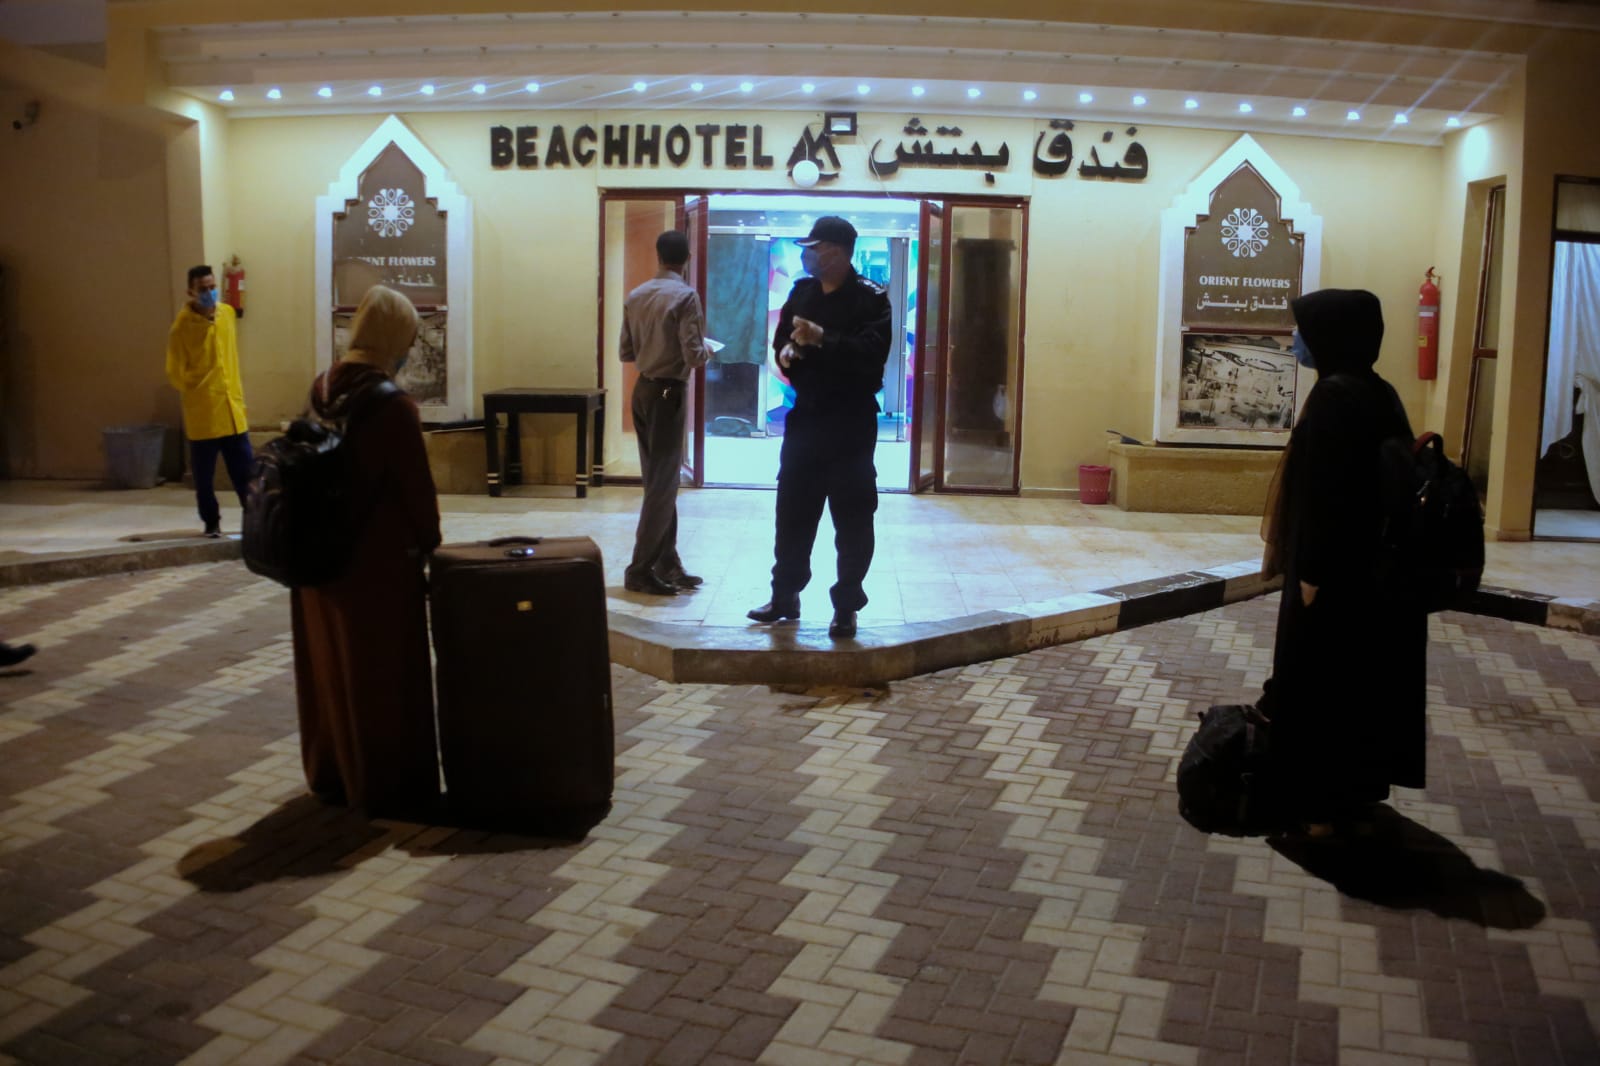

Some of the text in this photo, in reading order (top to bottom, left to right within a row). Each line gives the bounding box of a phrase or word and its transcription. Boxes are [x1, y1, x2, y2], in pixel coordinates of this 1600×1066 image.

[490, 123, 774, 168] BEACHHOTEL
[1032, 120, 1149, 180] فندق
[388, 256, 436, 266] FLOWERS
[1199, 275, 1291, 289] ORIENT FLOWERS
[1196, 292, 1288, 312] فندق بيتش
